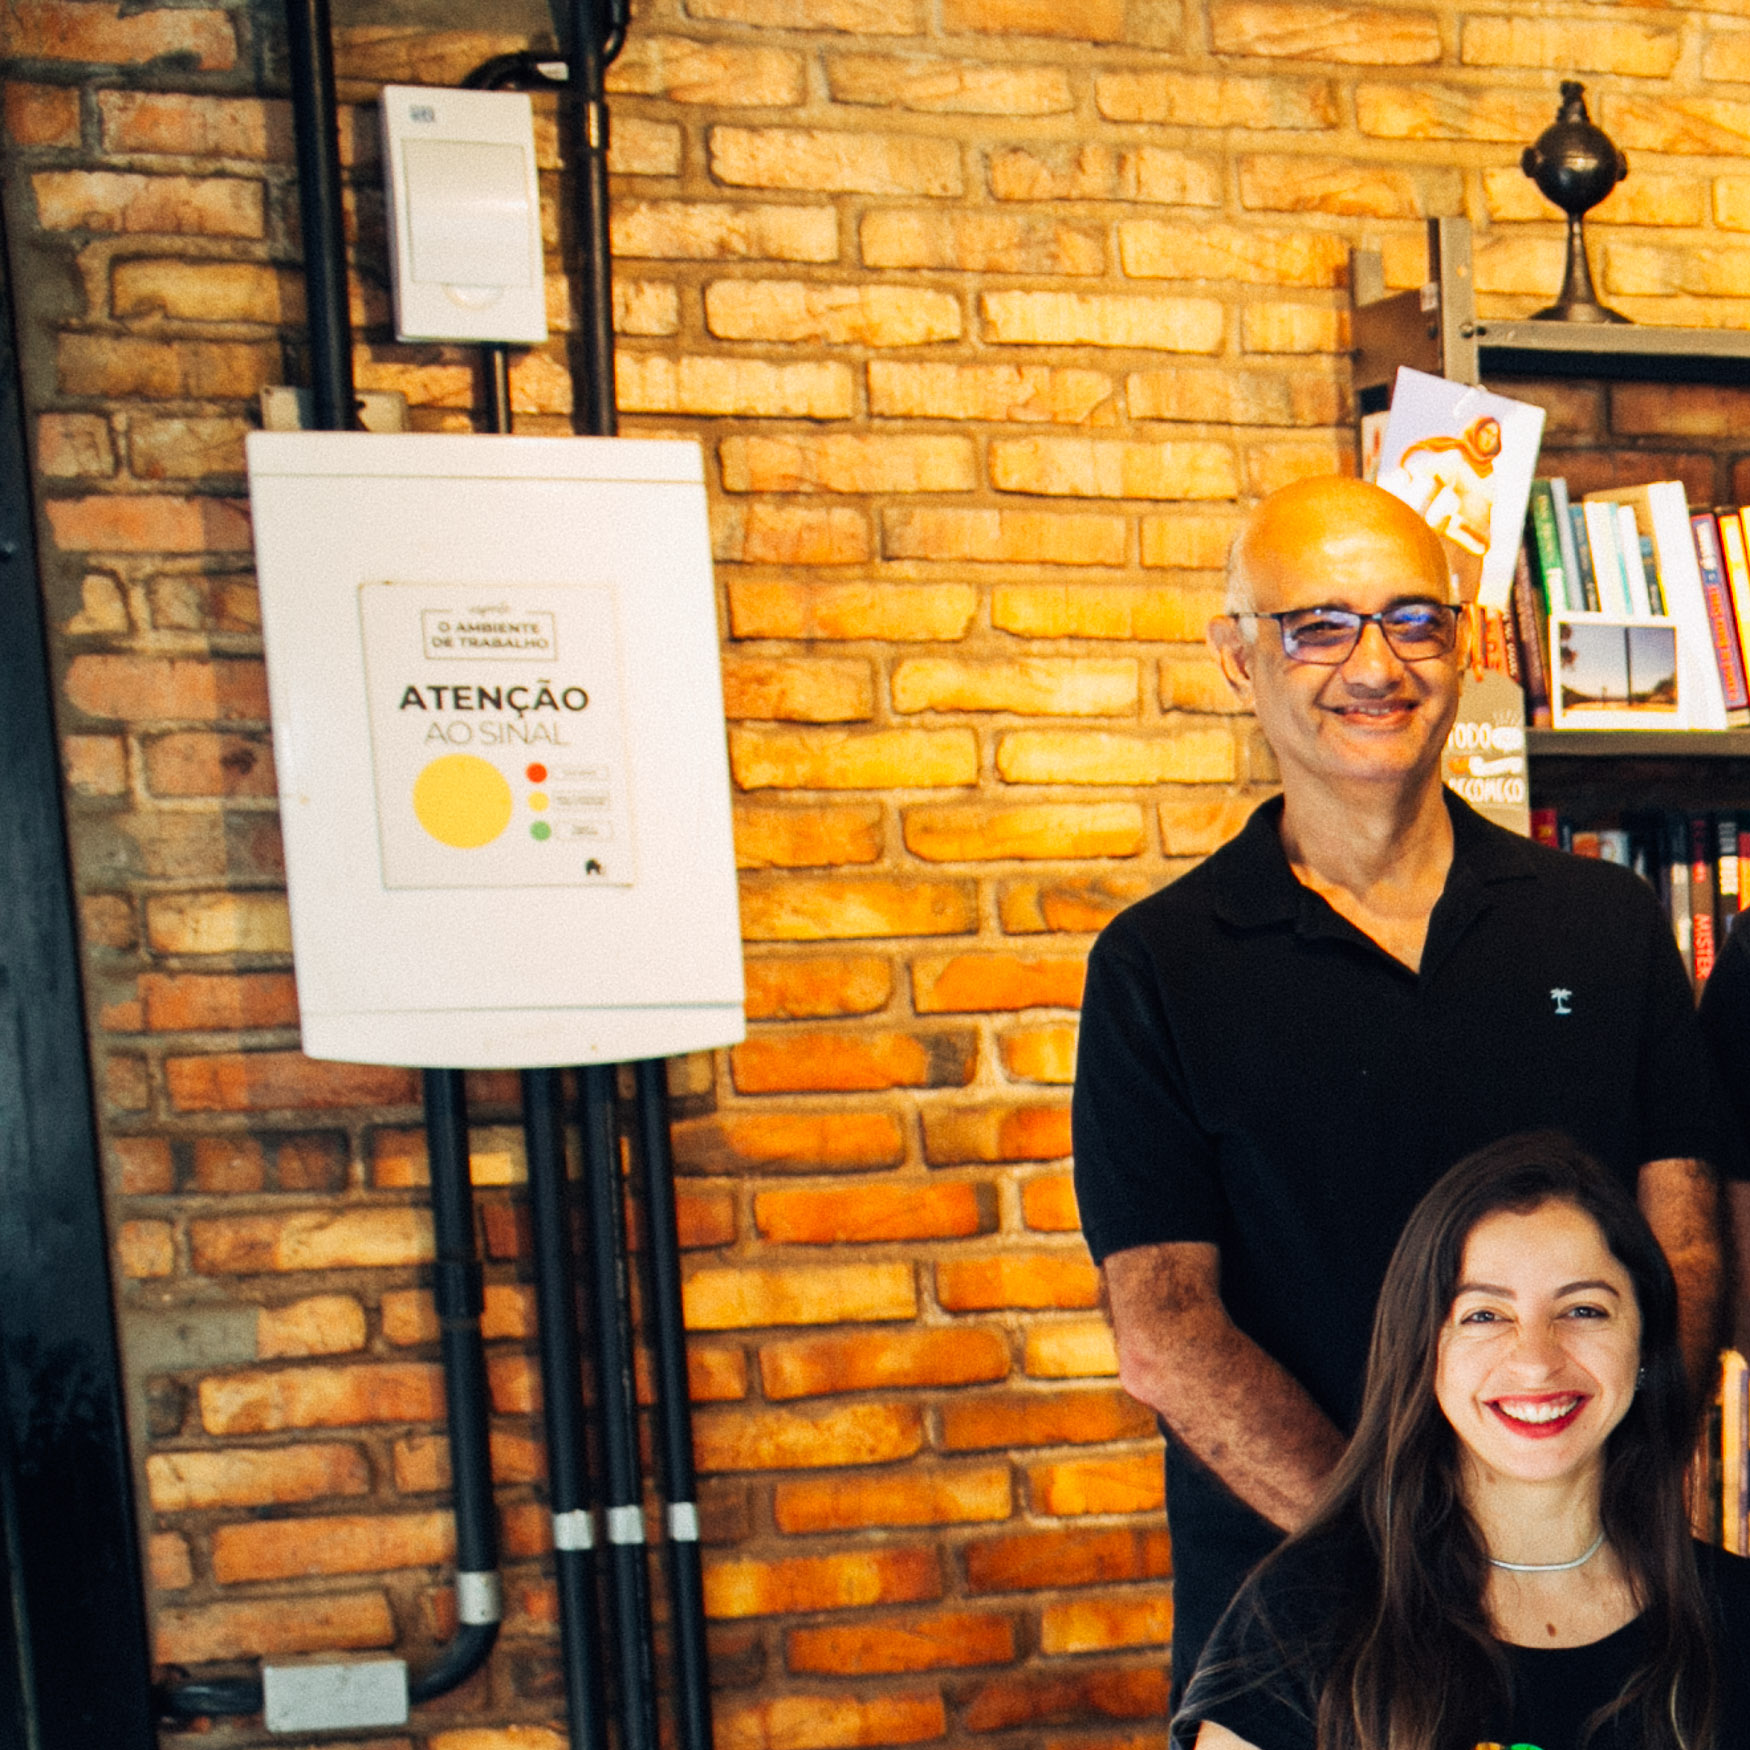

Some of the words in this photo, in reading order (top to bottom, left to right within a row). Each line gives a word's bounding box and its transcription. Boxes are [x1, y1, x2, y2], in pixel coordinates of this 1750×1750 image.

[438, 621, 451, 633] O
[456, 621, 540, 634] AMBIENTE
[432, 636, 451, 648] DE
[459, 637, 550, 649] TRABALHO
[400, 679, 590, 718] ATENÇÃO
[425, 720, 473, 746] AO
[479, 720, 572, 747] SINAL
